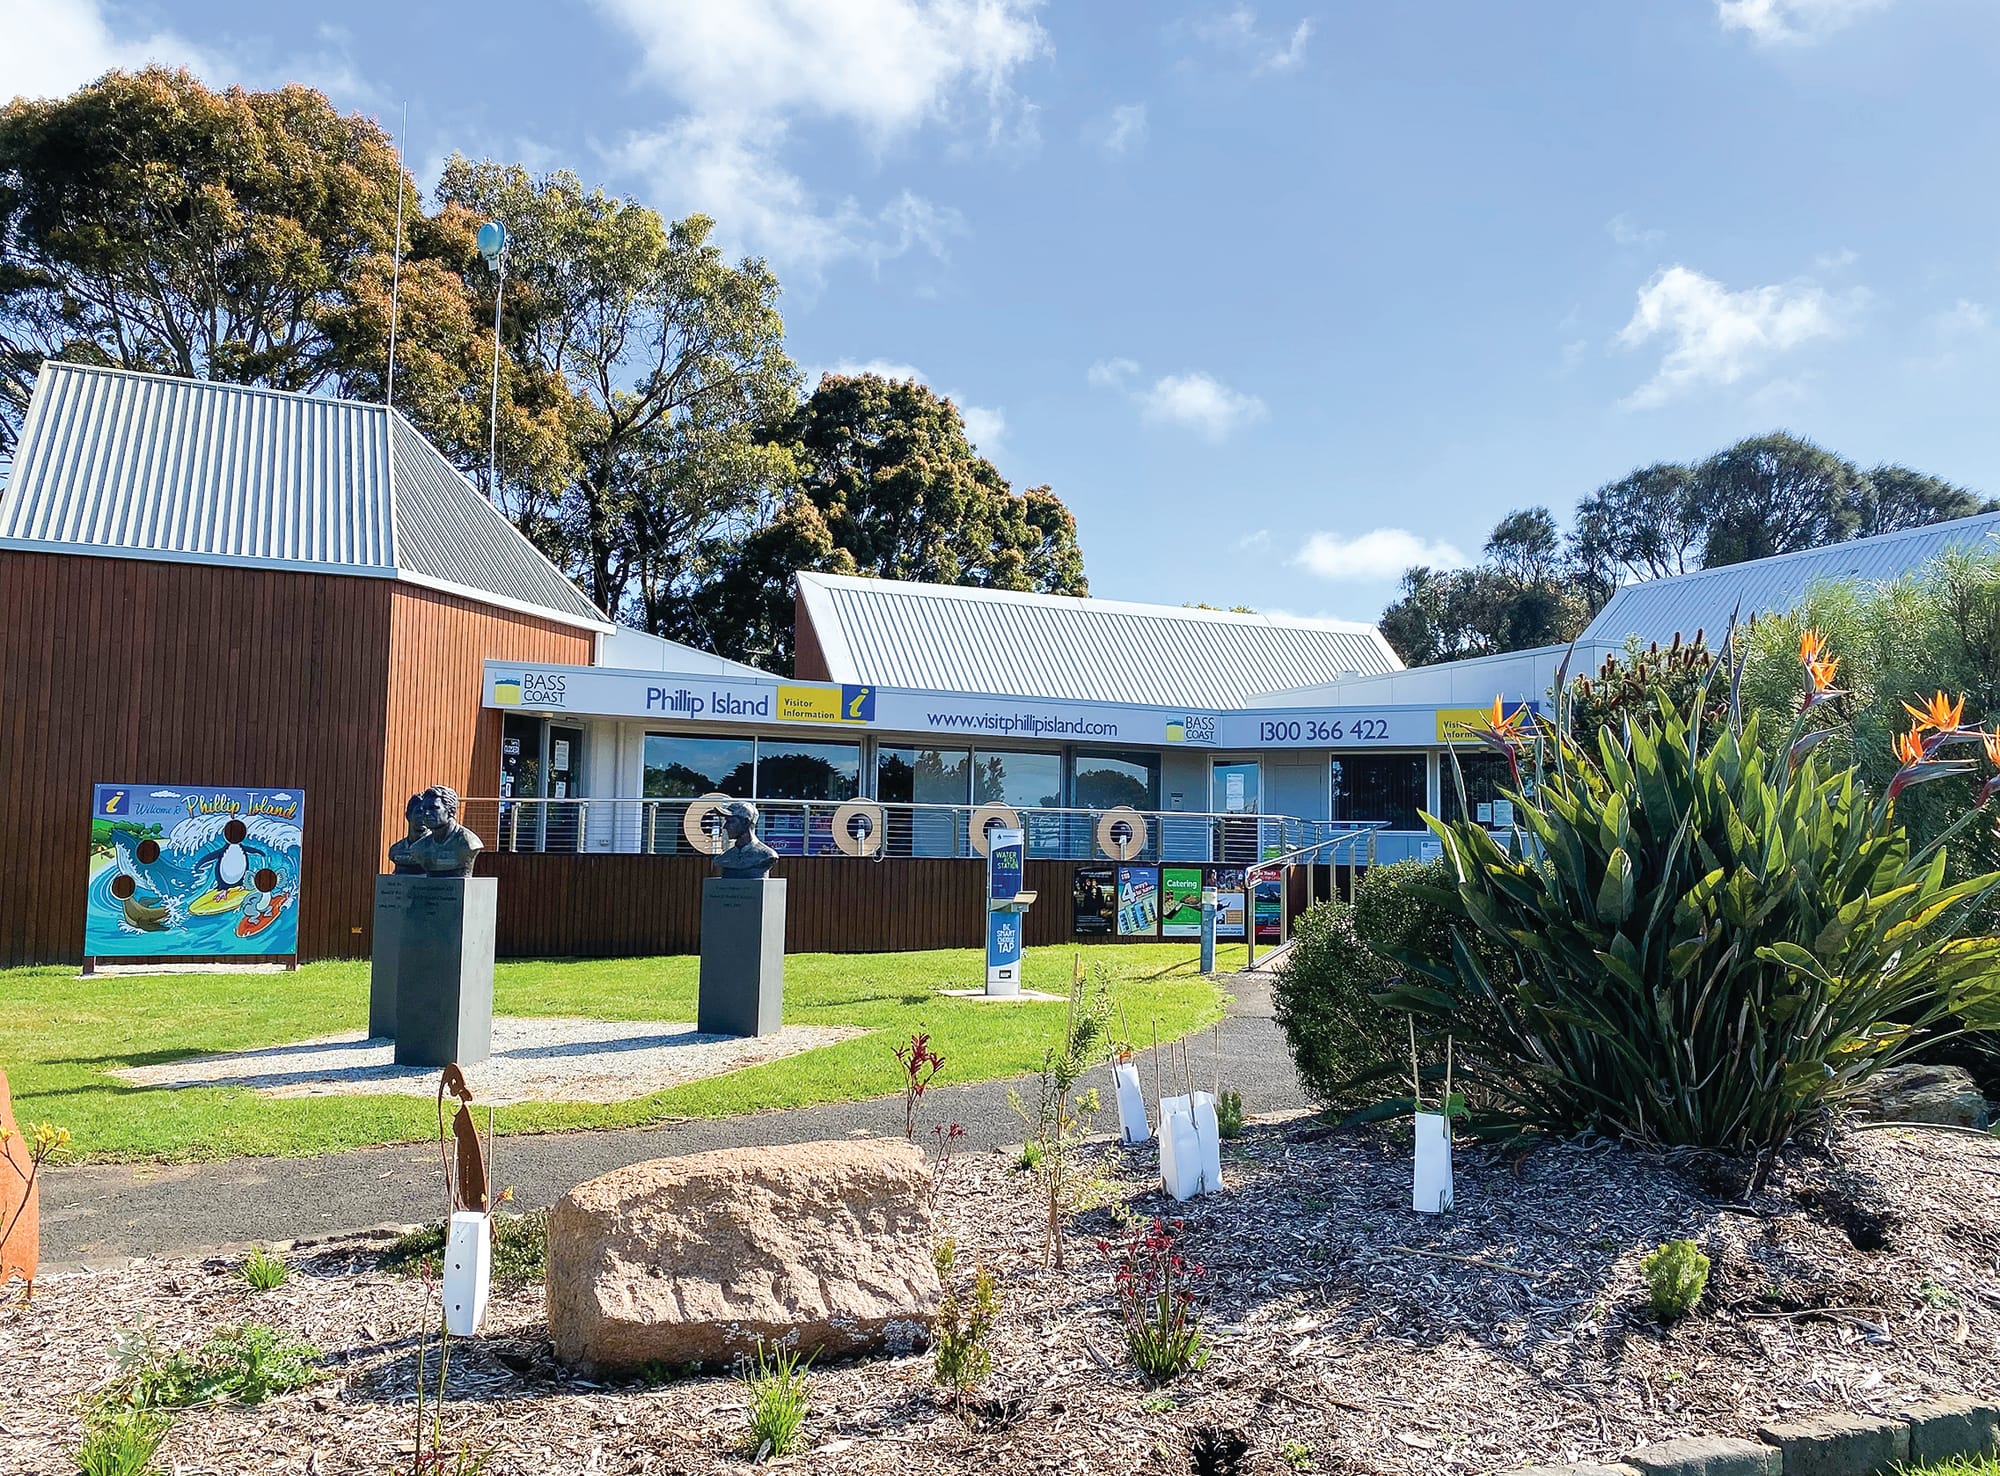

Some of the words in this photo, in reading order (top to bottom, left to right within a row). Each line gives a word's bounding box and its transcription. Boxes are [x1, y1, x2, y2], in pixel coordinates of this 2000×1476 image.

[524, 673, 566, 691] BASS
[523, 690, 566, 703] COAST
[646, 687, 705, 718] Phillip
[711, 691, 769, 717] Island
[784, 698, 813, 708] Visitor
[783, 708, 835, 720] Information
[927, 713, 1118, 737] www.visitphillipisland.com
[1185, 716, 1215, 731] BASS
[1186, 729, 1215, 740] COAST
[1260, 721, 1301, 742] 1300
[1306, 720, 1344, 741] 366
[1349, 719, 1389, 740] 422
[135, 802, 172, 815] Welcome
[181, 793, 241, 819] Phillip
[246, 792, 298, 820] Island
[995, 851, 1017, 859] WATER
[1166, 879, 1198, 890] Catering
[1121, 881, 1138, 904] 4
[1002, 923, 1011, 931] BE
[996, 930, 1015, 938] SMART
[998, 942, 1015, 954] TAP
